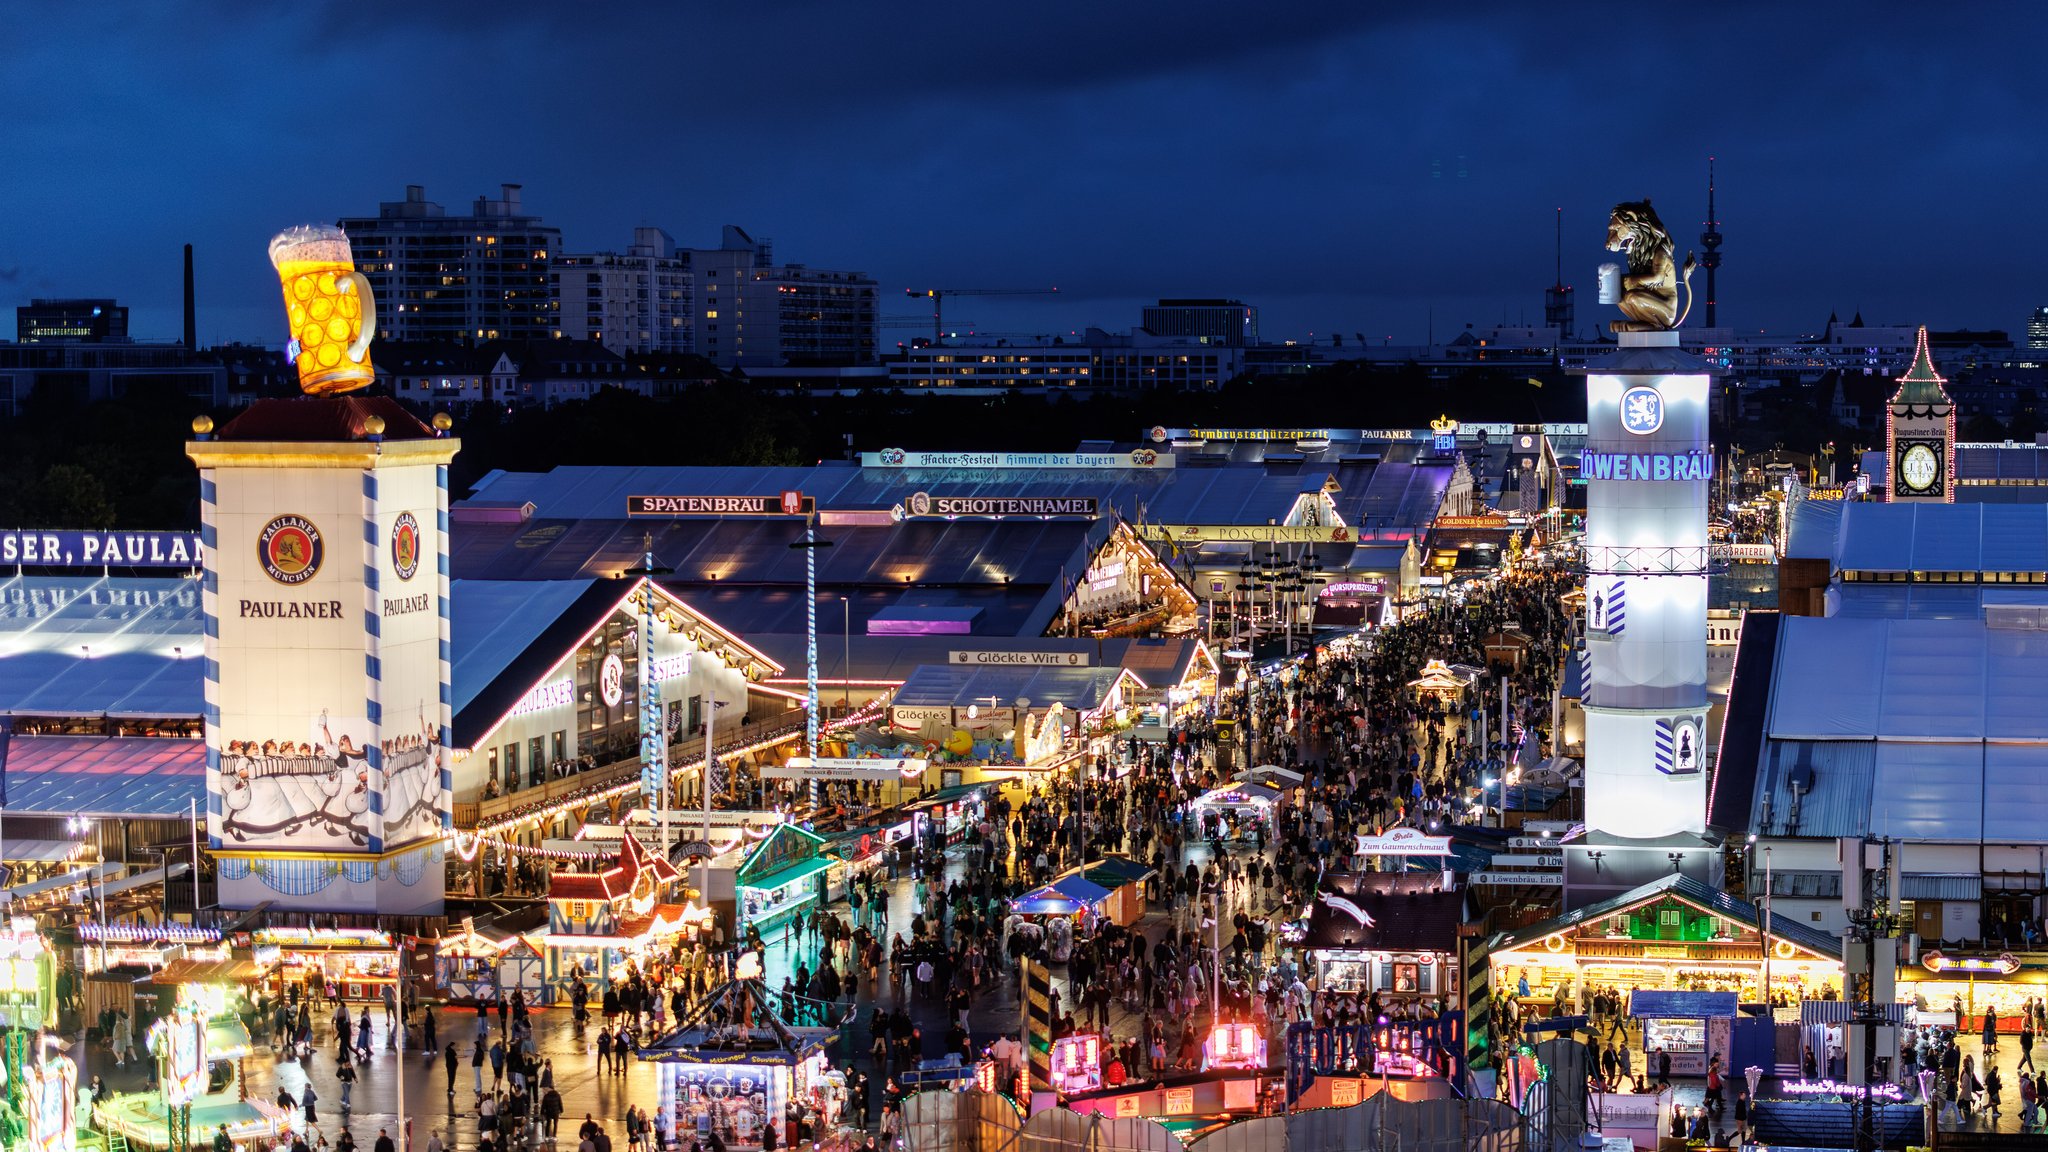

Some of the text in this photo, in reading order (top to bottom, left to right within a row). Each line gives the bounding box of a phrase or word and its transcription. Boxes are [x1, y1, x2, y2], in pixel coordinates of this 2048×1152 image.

[1361, 430, 1412, 439] PAULANER
[920, 453, 1115, 467] Hacker-Festzelt Himmel der Bayern
[1580, 449, 1713, 481] LÖWENBRÄU
[643, 497, 765, 513] SPATENBRÄU
[938, 499, 1094, 514] SCHOTTENHAMEL
[262, 517, 319, 543] PAULANER
[392, 513, 419, 540] PAULANER
[1219, 527, 1322, 541] POSCHNER'S
[3, 535, 73, 566] SER,
[267, 564, 316, 583] MÜNCHEN
[239, 599, 344, 619] PAULANER
[383, 593, 429, 617] PAULANER
[977, 652, 1059, 664] Glöckle Wirt
[896, 709, 947, 720] Glöckle's
[1362, 841, 1445, 851] Zum Gaumenschmaus
[1492, 875, 1538, 883] Löwenbräu.
[1540, 875, 1554, 884] Ein
[709, 1052, 746, 1064] Mitbringsel
[751, 1055, 786, 1065] Souvenirs
